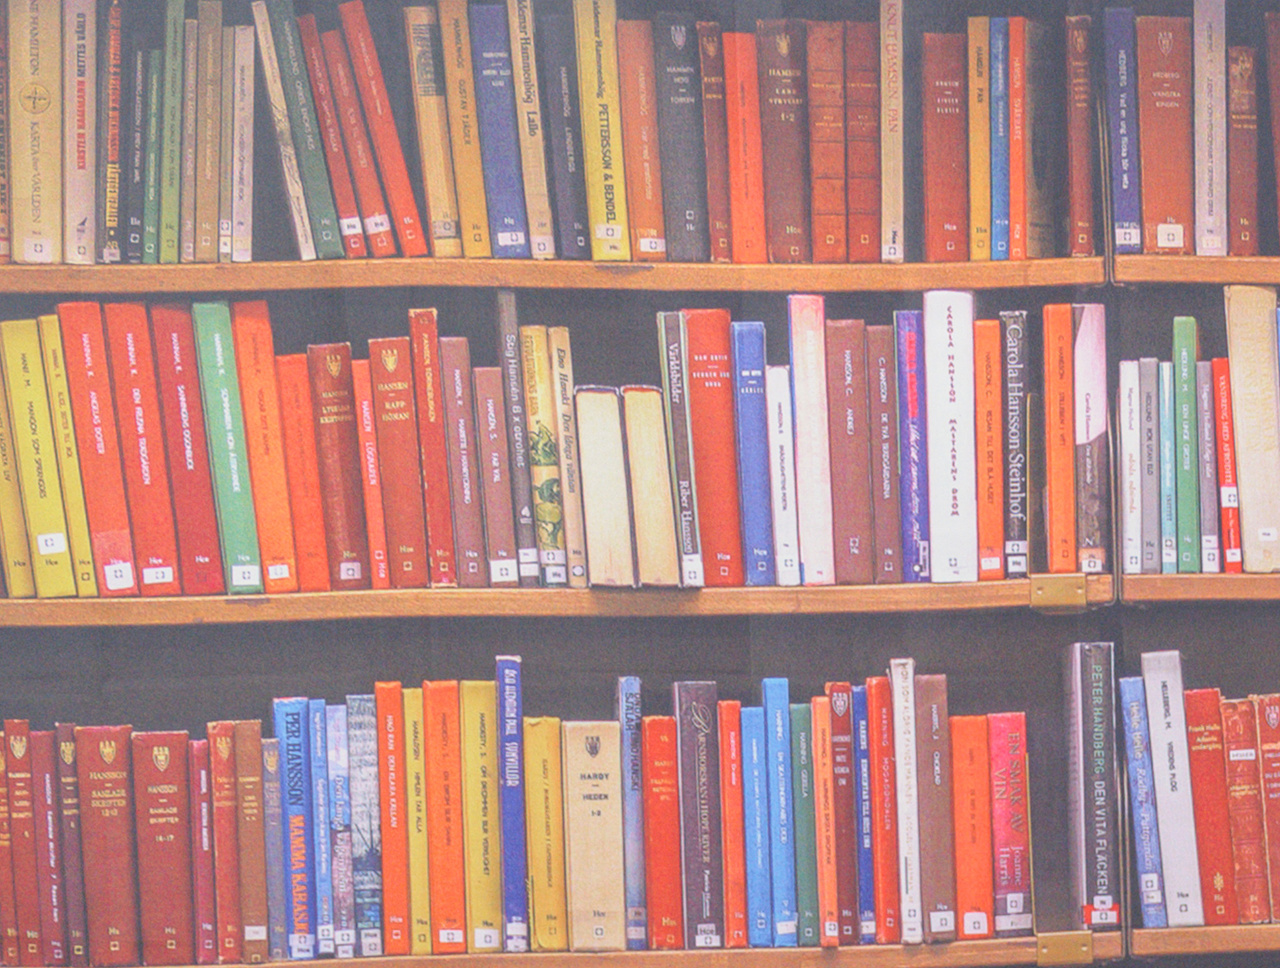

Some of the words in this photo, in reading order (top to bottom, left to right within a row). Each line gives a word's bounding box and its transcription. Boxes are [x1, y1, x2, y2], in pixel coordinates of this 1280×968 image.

[75, 13, 87, 41] VÄRLD
[886, 2, 898, 39] KNUT
[29, 16, 40, 76] HAMILTON
[76, 43, 87, 78] METTES
[521, 37, 536, 104] Hammenhög
[595, 40, 605, 99] Hammenhög
[885, 43, 898, 100] HAMSUN
[1118, 50, 1128, 87] HEDBERG
[976, 88, 984, 103] PAN
[1119, 93, 1129, 108] Vad
[1119, 109, 1127, 119] en
[30, 121, 40, 156] KARTA
[598, 104, 614, 170] PETTERSSON
[887, 109, 898, 133] PAN
[1117, 120, 1127, 135] ung
[1119, 136, 1130, 158] flicka
[106, 163, 120, 228] TÅRTGENERALEN
[604, 174, 613, 182] &
[1121, 173, 1130, 189] veta
[604, 184, 616, 223] BENDEL
[504, 334, 518, 357] Stig
[1006, 324, 1024, 378] Carola
[507, 359, 523, 402] Hansén
[558, 373, 571, 406] Hanski
[668, 342, 682, 404] Världsbilder
[1219, 375, 1229, 418] VANDRING
[562, 414, 573, 433] Den
[1007, 382, 1025, 449] Hansson
[1221, 420, 1231, 439] MED
[513, 425, 526, 469] otrohet
[1222, 441, 1233, 484] AFRODITE
[679, 481, 691, 509] Riber
[1008, 453, 1027, 522] Steinhof
[682, 511, 695, 554] Hansson
[1092, 664, 1105, 705] PETER
[286, 712, 301, 741] PER
[881, 707, 889, 746] HARNING
[1008, 731, 1021, 755] EN
[1093, 707, 1106, 774] HANDBERG
[287, 742, 304, 806] HANSSON
[387, 755, 397, 772] DEN
[582, 793, 609, 801] HEDEN
[993, 768, 1008, 800] VIN
[1008, 759, 1022, 806] SMAK
[1094, 780, 1106, 806] DEN
[699, 804, 710, 832] HOPE
[1009, 810, 1024, 833] AV
[1094, 808, 1107, 837] VITA
[289, 814, 306, 869] MAMMA
[700, 834, 710, 863] RIVER
[999, 847, 1012, 886] Harris
[1012, 844, 1025, 886] Joanne
[1096, 838, 1110, 895] FLÄCKEN
